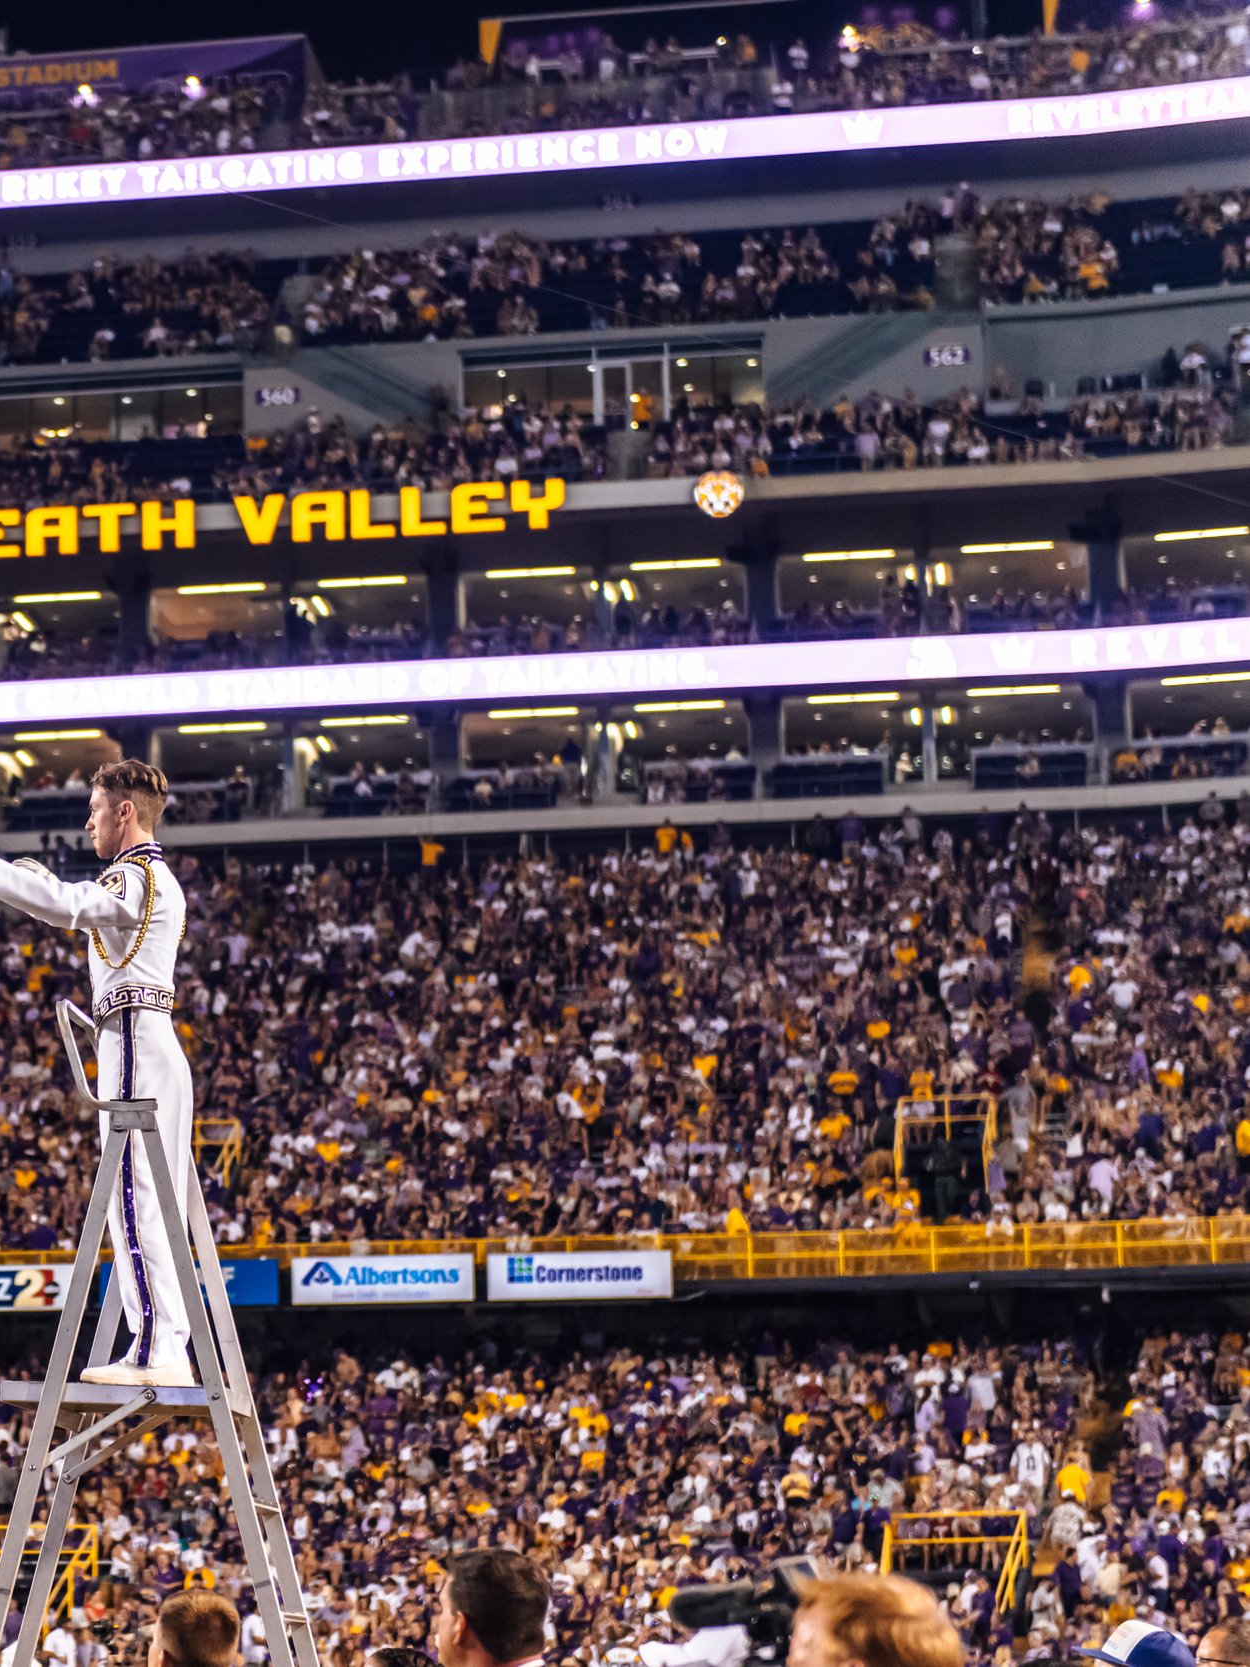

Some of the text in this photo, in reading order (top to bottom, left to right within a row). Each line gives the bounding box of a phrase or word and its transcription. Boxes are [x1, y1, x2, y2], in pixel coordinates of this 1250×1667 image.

[137, 151, 364, 193] TAILGATING
[378, 133, 620, 177] EXPERIENCE
[635, 126, 728, 159] NOW
[930, 346, 965, 367] 562
[261, 387, 296, 407] 560
[233, 478, 566, 544] VALLEY
[207, 666, 409, 707] STANDARD
[418, 663, 473, 697] OF
[13, 1269, 46, 1309] 2
[343, 1265, 460, 1286] Albertsons
[535, 1265, 643, 1284] Cornerstone
